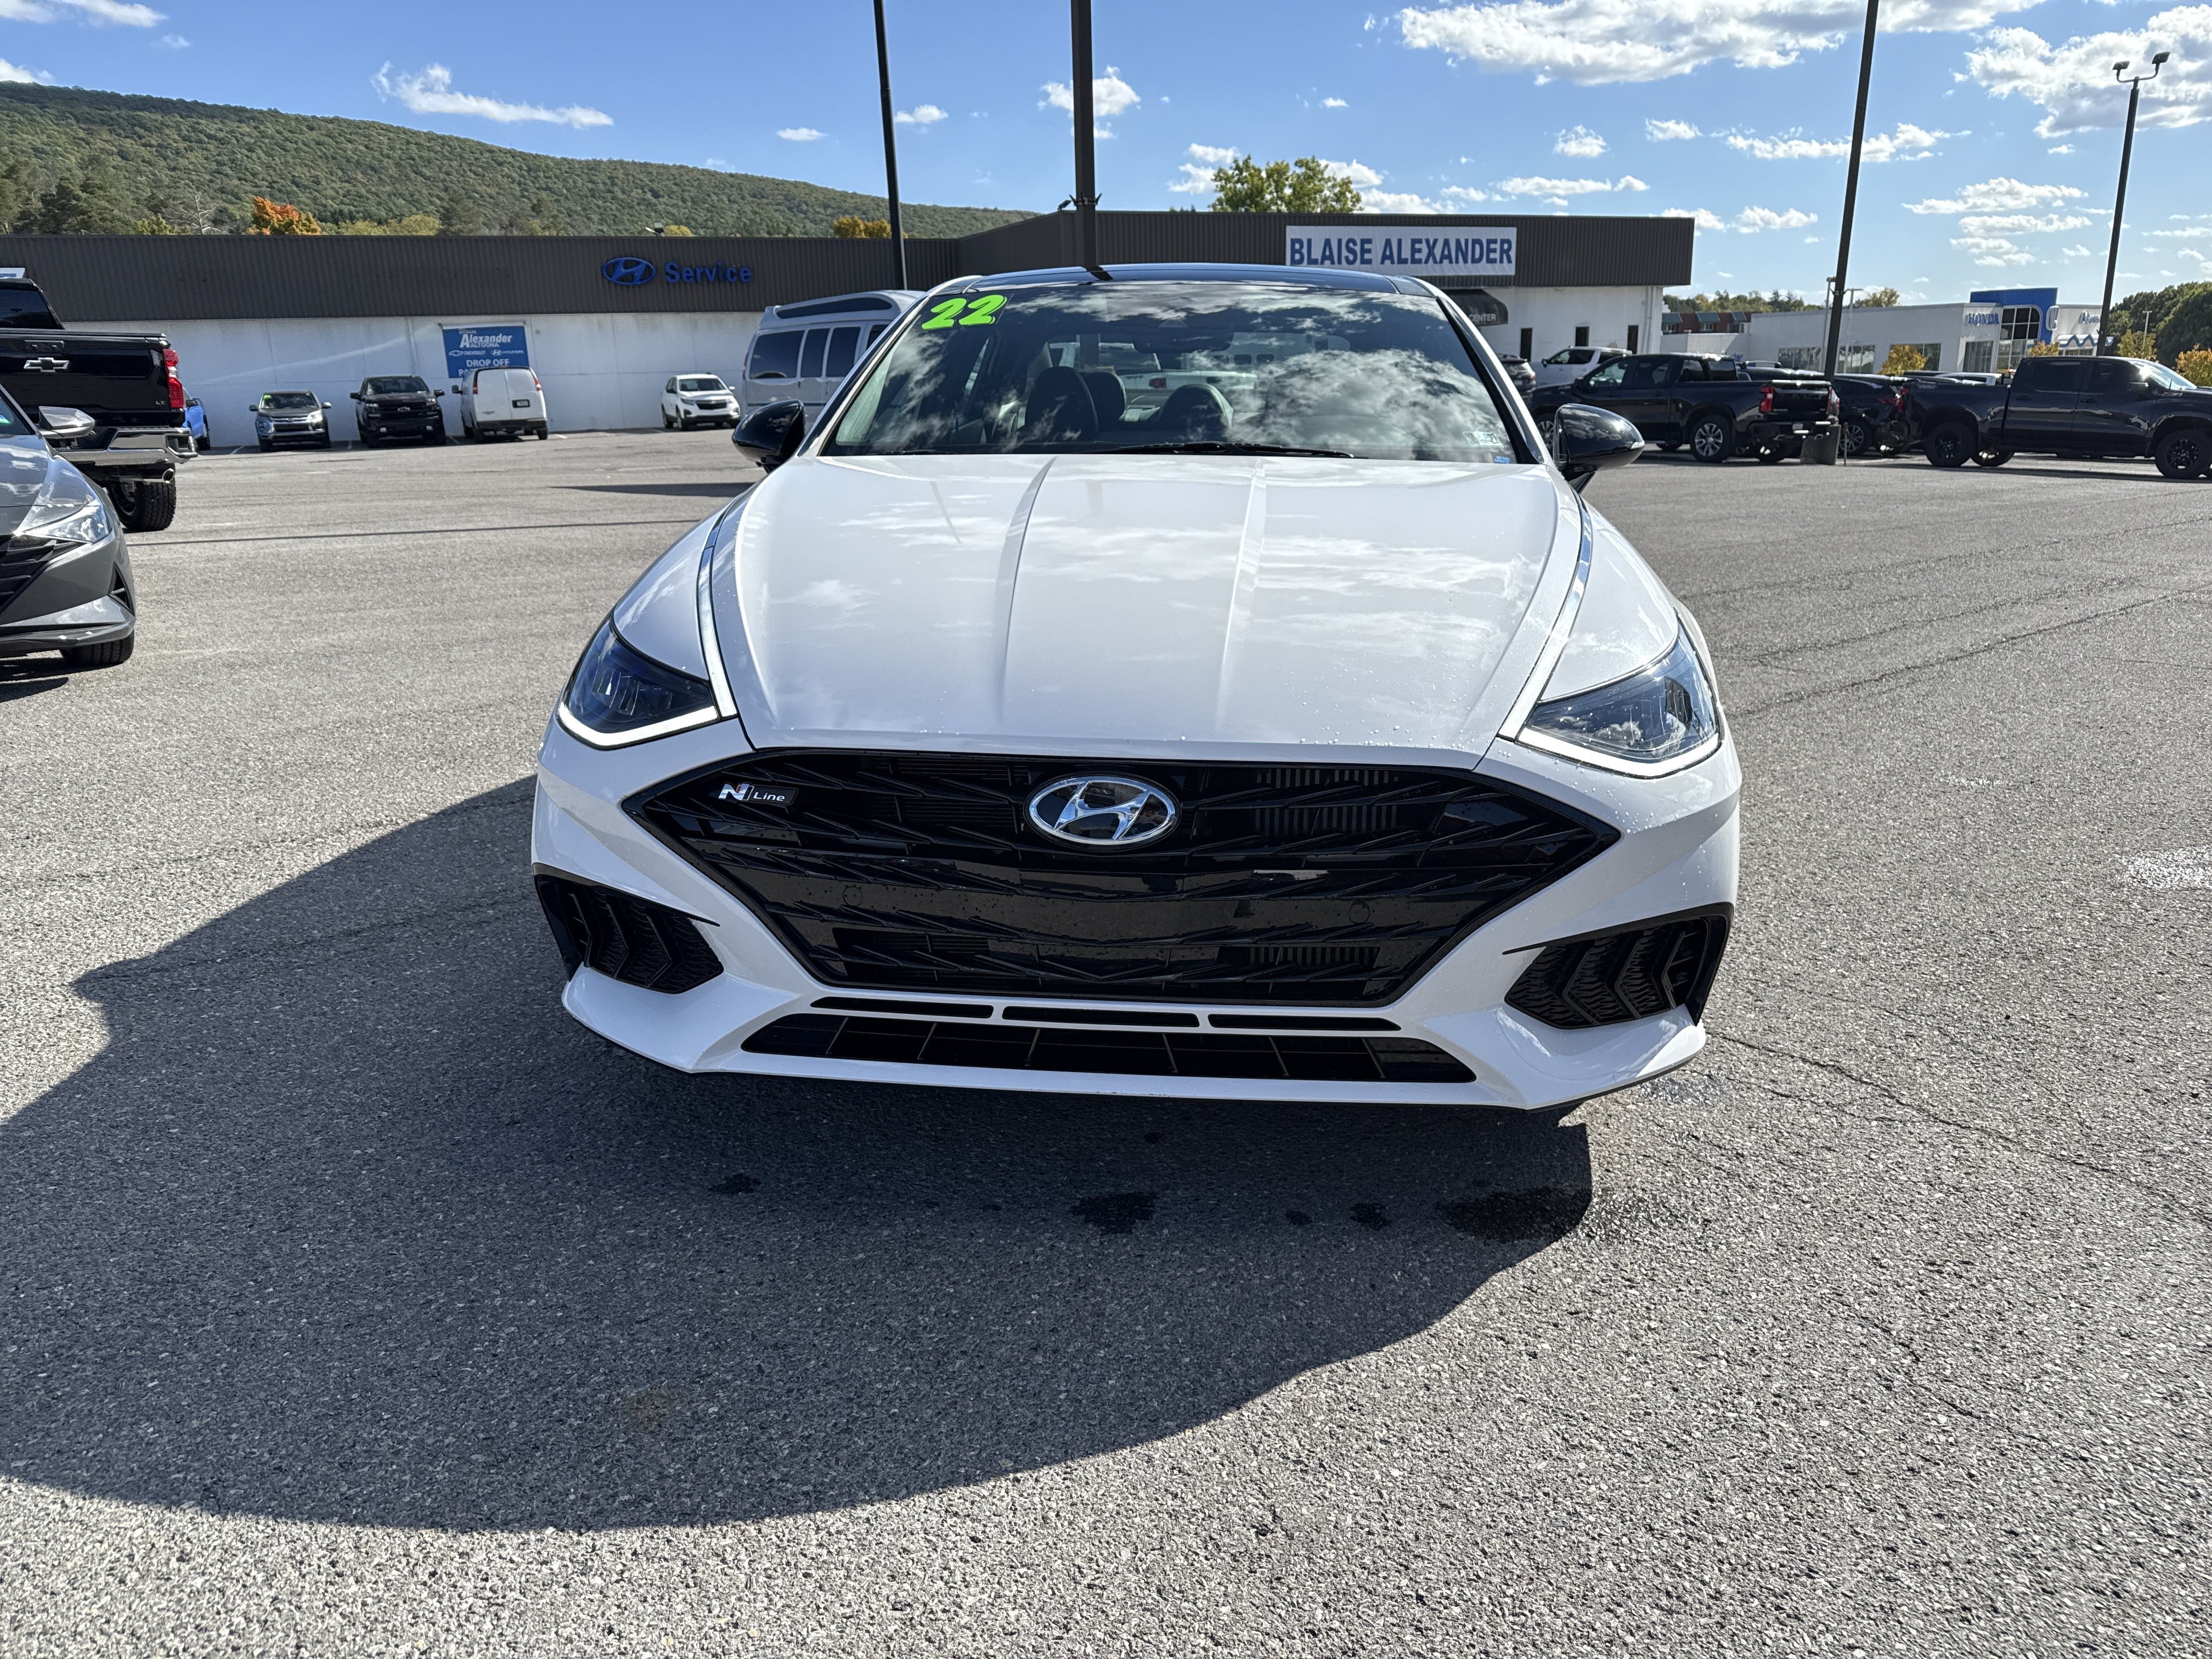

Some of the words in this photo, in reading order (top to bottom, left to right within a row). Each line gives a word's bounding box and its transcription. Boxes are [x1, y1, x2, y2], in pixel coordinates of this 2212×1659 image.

[1290, 238, 1372, 265] BLAISE
[1380, 238, 1513, 264] ALEXANDER
[664, 261, 752, 284] Service
[922, 295, 1008, 329] 22
[1469, 313, 1497, 322] CENTER
[1967, 313, 2000, 325] HONDA
[459, 333, 512, 348] Alexander
[493, 358, 510, 366] OFF
[718, 783, 750, 801] N
[753, 792, 785, 802] Line
